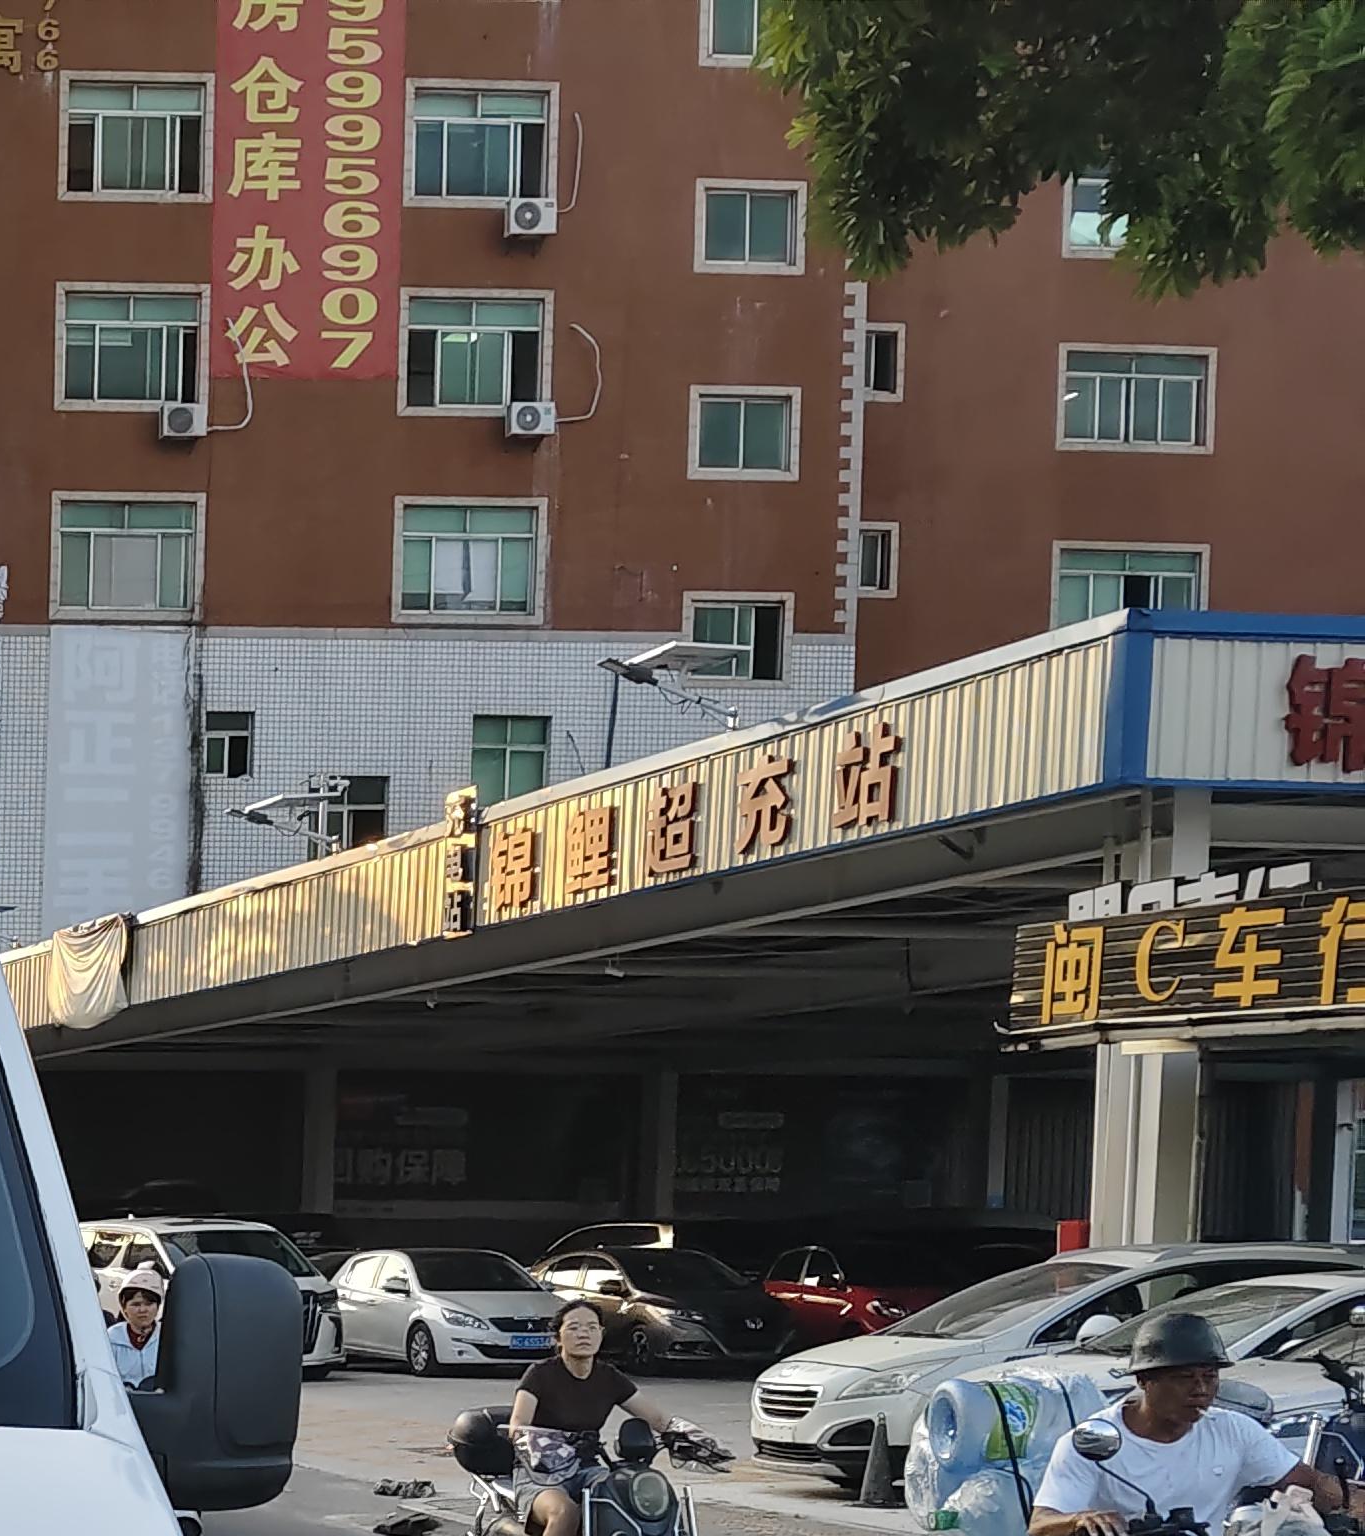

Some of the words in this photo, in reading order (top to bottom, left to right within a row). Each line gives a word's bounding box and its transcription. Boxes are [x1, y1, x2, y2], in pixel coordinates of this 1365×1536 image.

[488, 722, 903, 909] 锦鲤超充站
[1040, 896, 1365, 1026] 闽C车行
